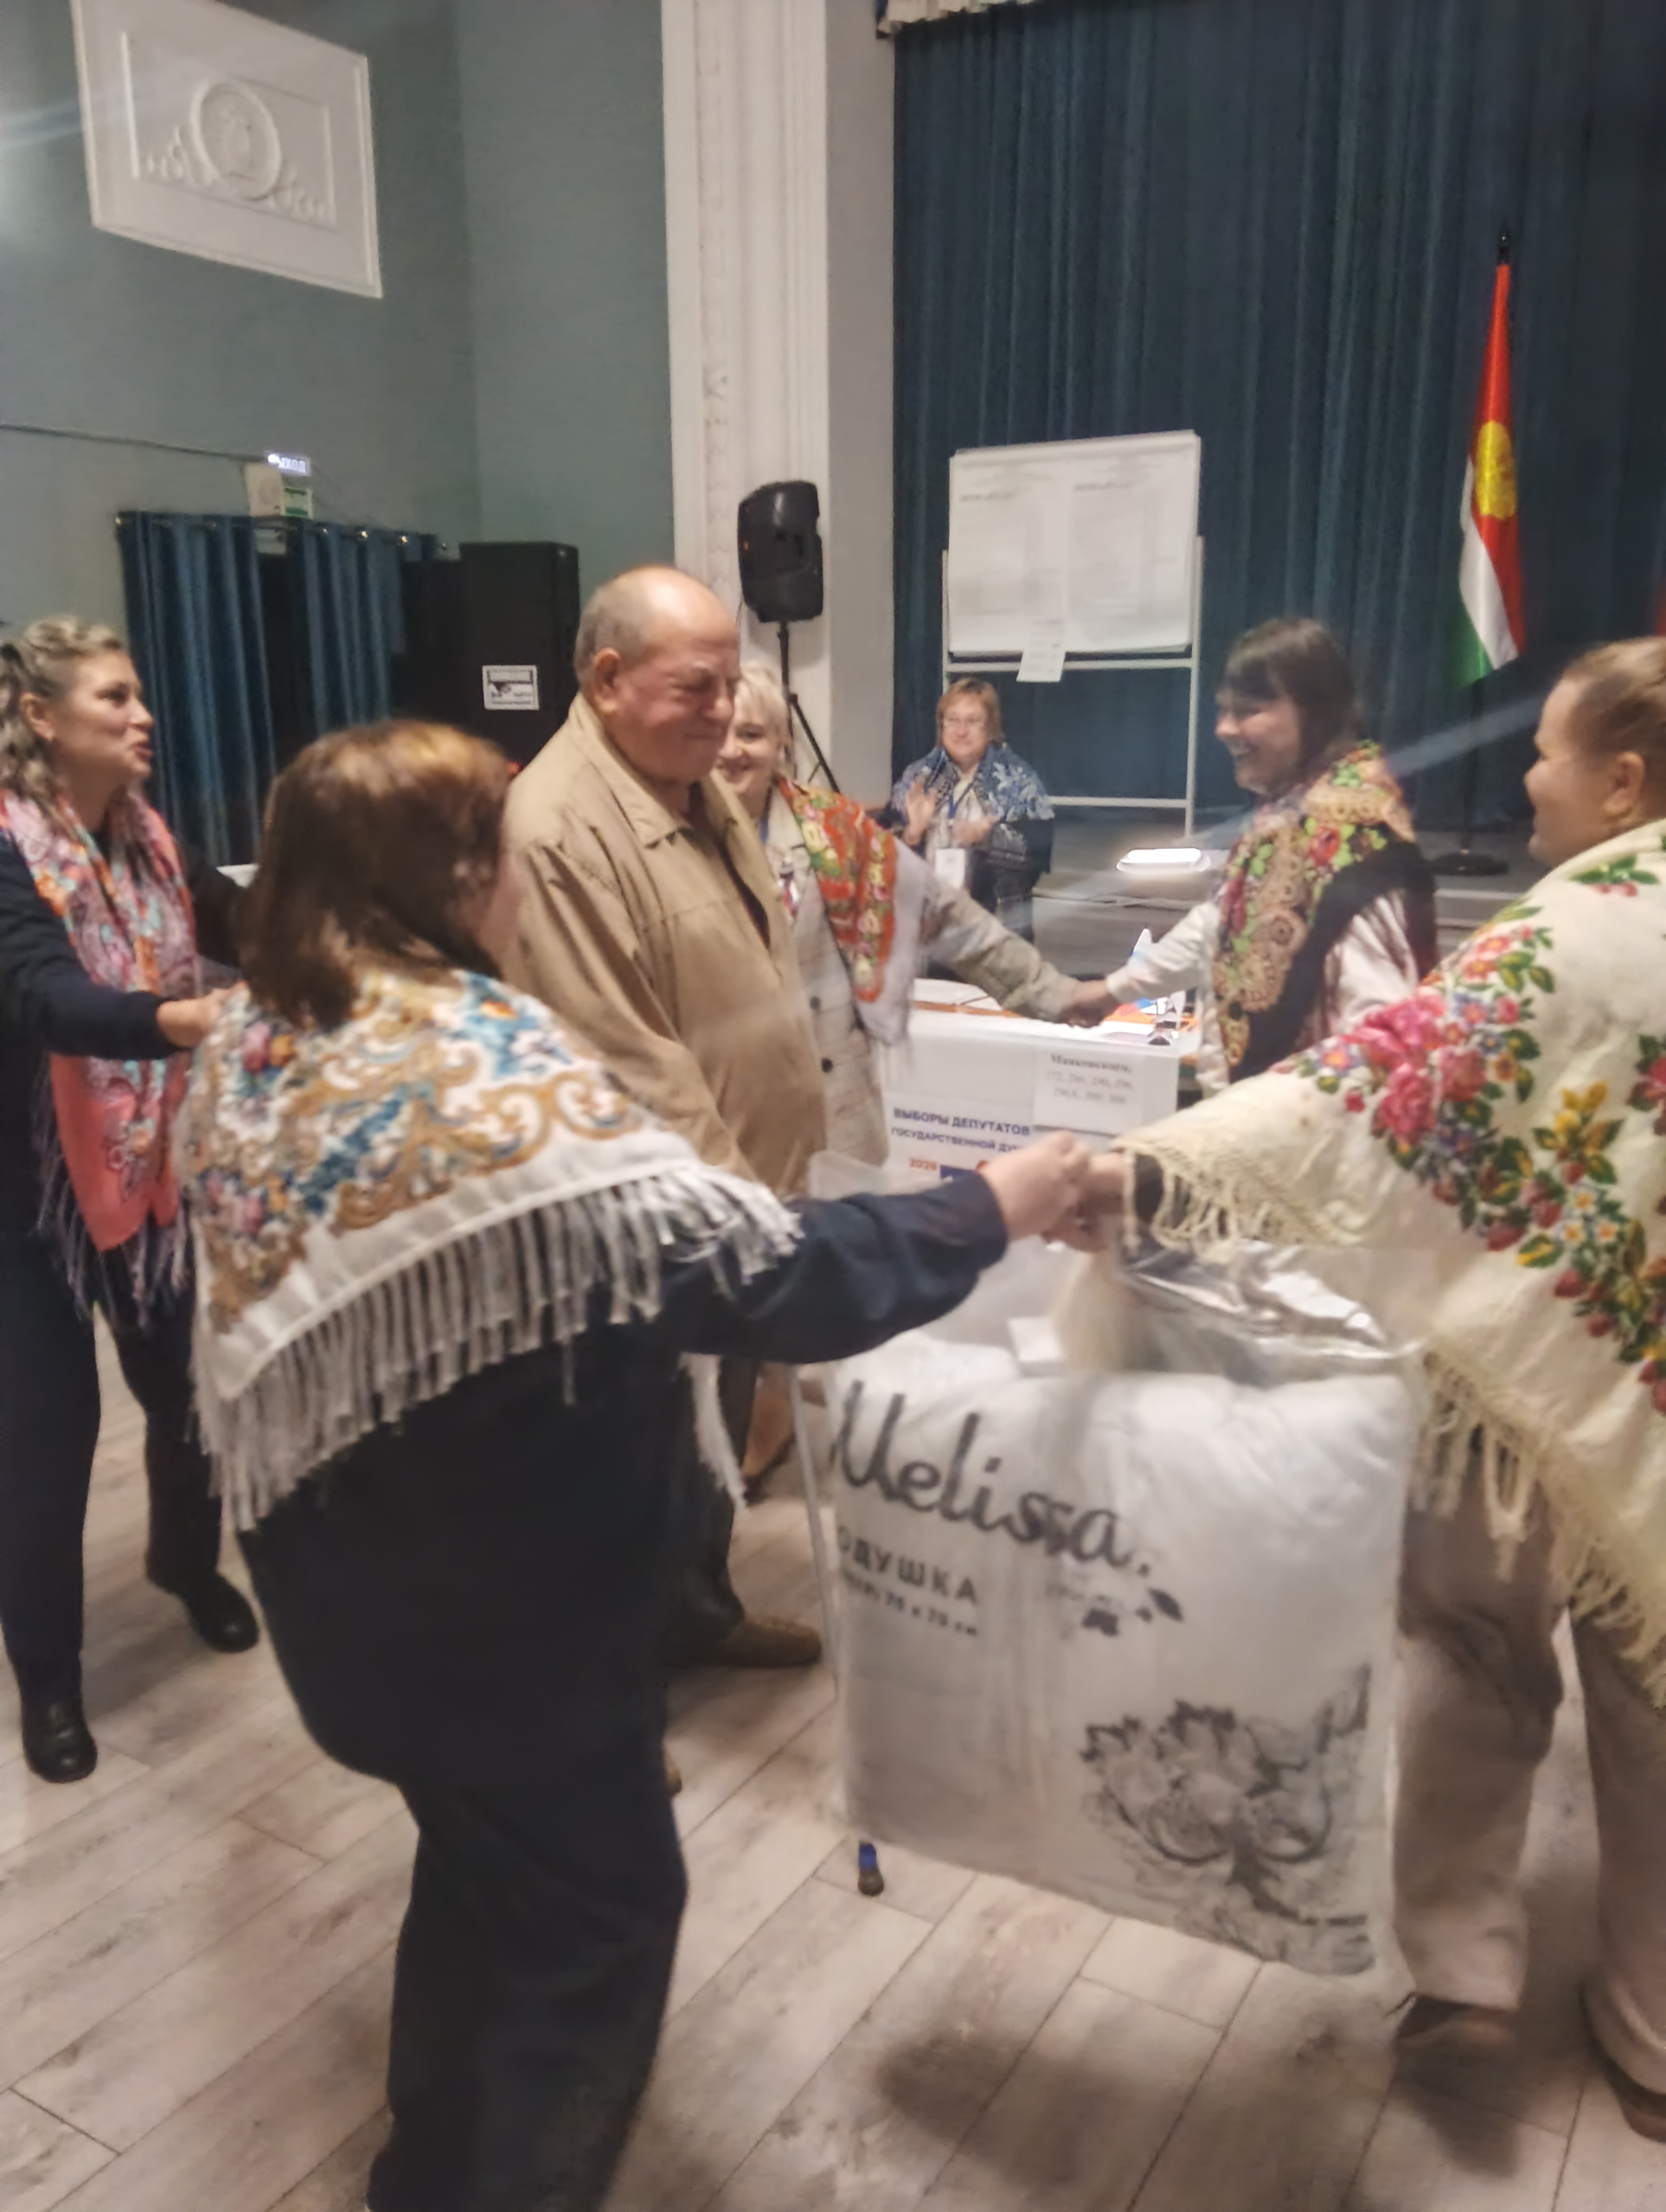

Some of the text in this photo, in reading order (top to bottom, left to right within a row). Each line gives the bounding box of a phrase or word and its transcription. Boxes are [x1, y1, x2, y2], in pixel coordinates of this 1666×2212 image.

[270, 455, 306, 473] ЫХОД
[894, 1108, 1030, 1136] ВЫБОРЫ ДЕПУТАТОВ
[891, 1127, 996, 1150] ГОСУДАРСТВЕННОЙ
[837, 1525, 978, 1606] ОДУШКА
